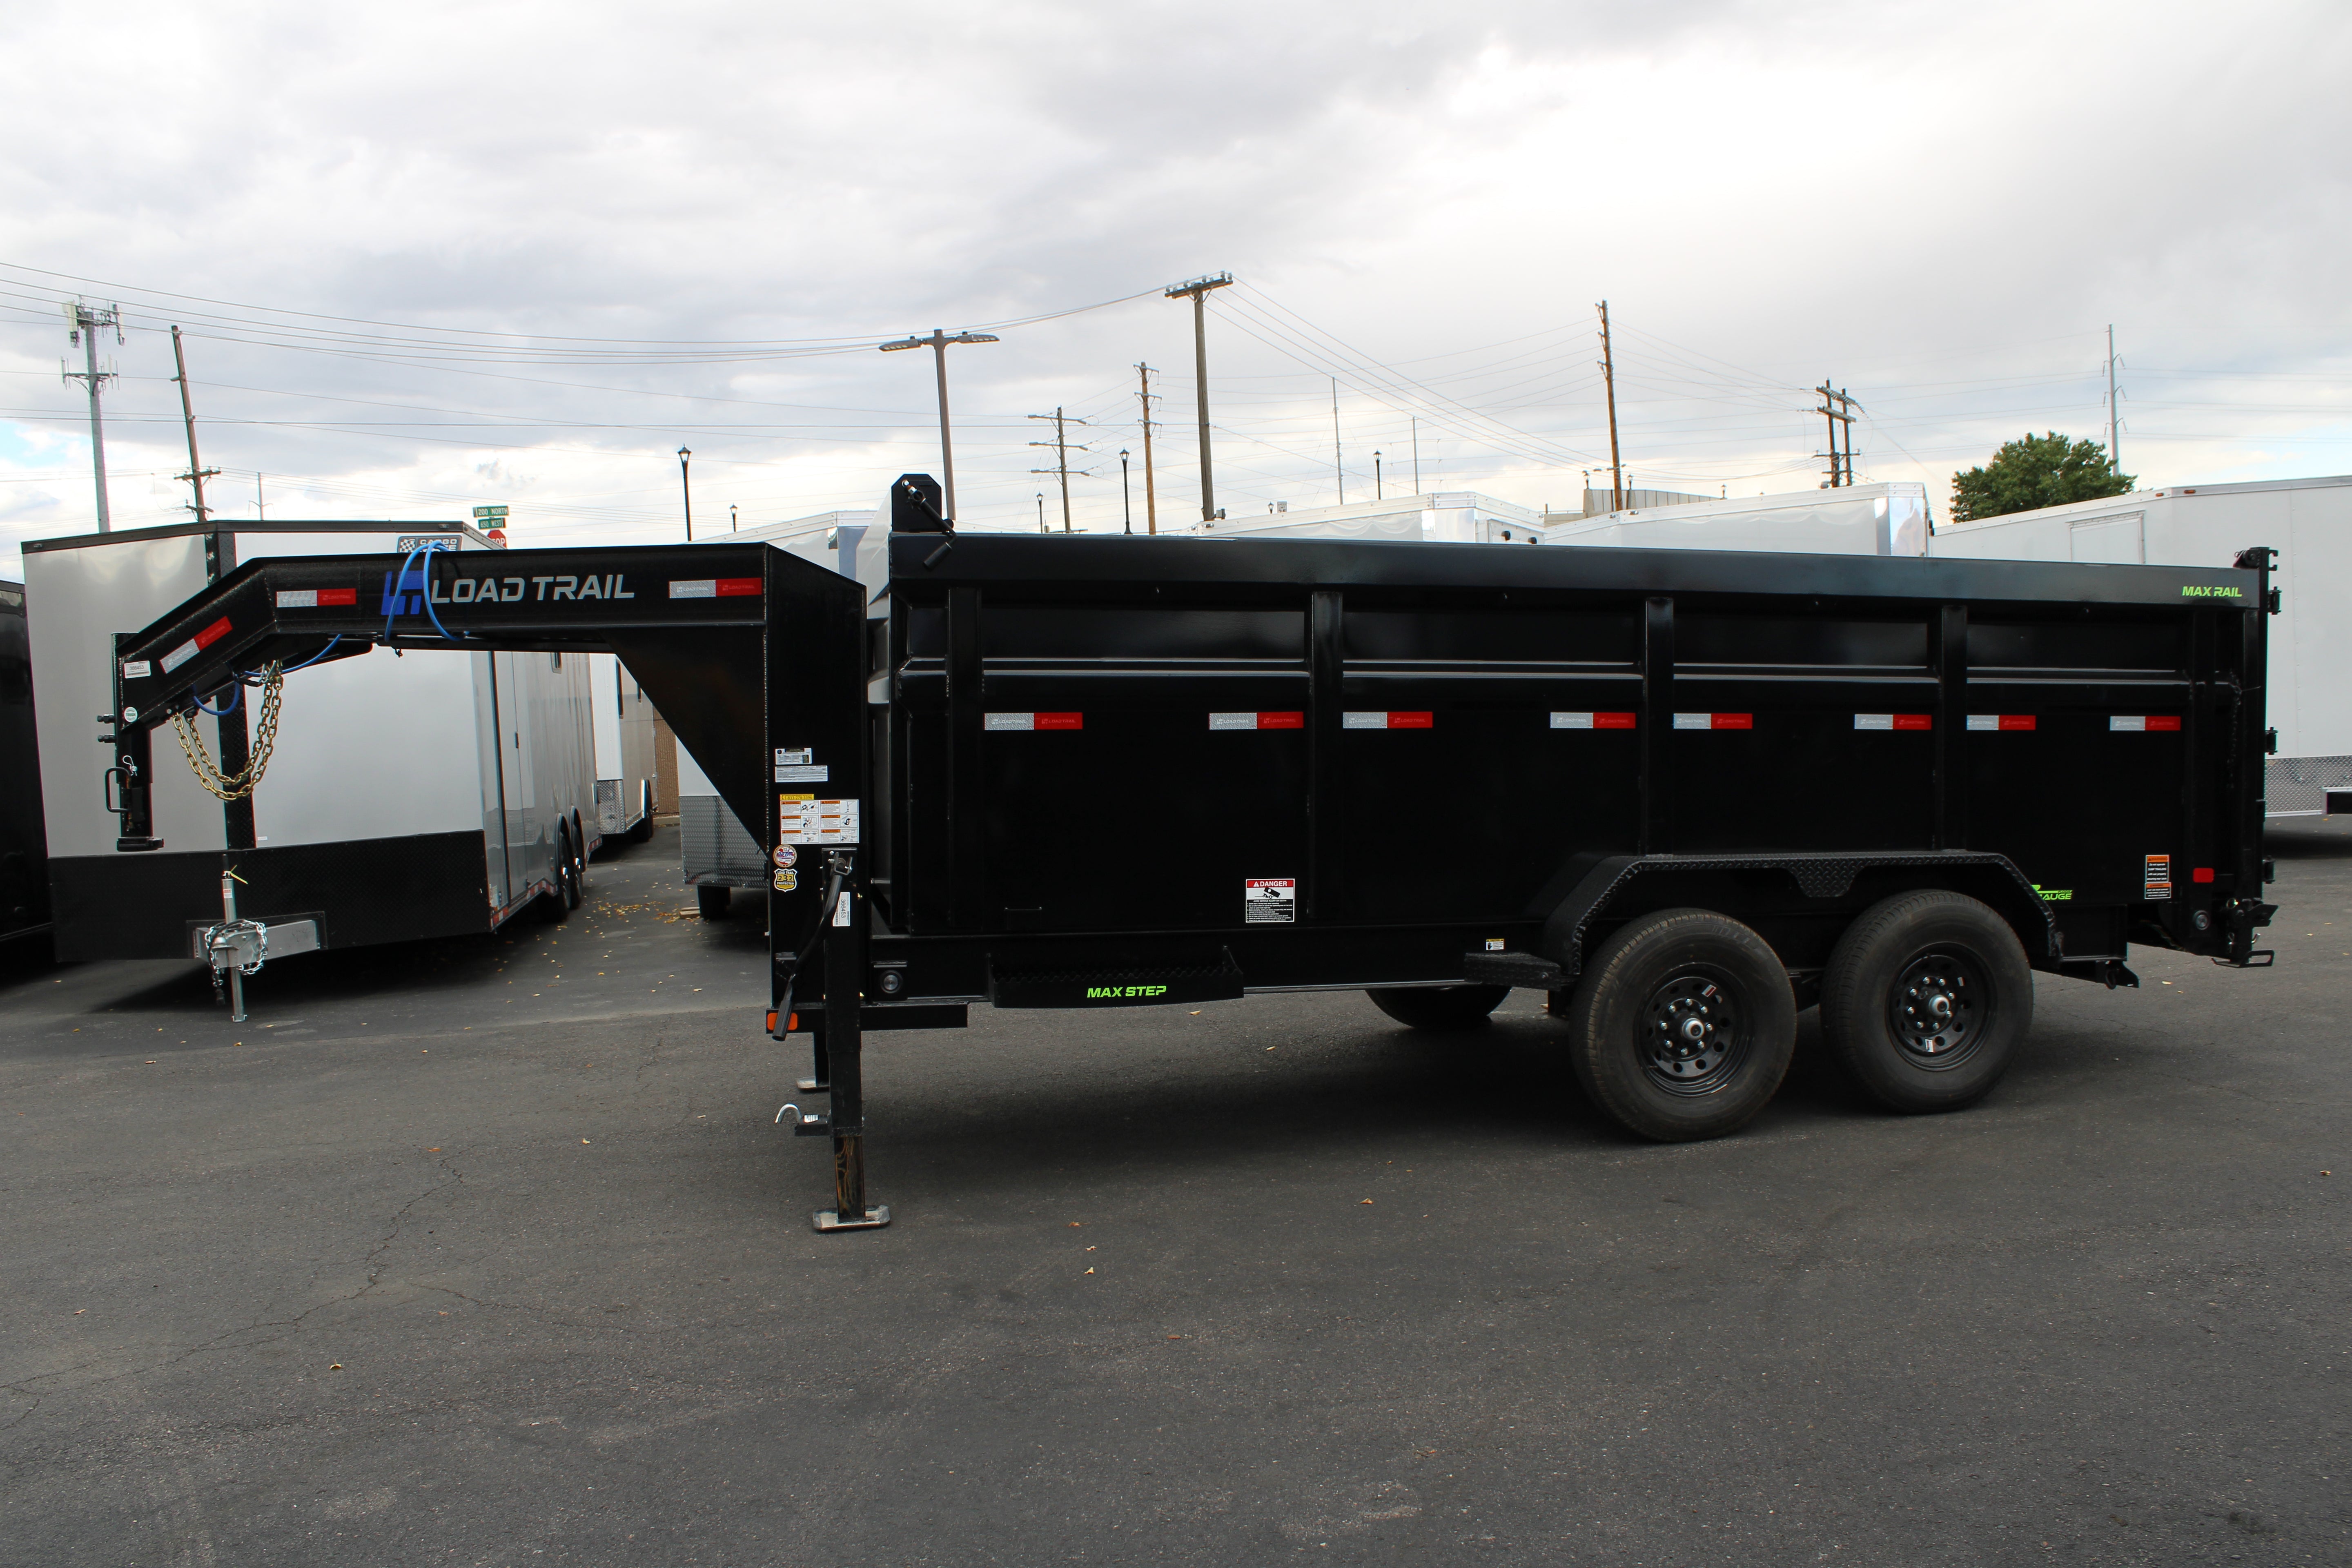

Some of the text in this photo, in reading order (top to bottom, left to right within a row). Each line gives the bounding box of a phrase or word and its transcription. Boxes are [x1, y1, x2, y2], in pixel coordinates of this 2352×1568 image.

[431, 577, 525, 604] LOAD
[532, 574, 635, 601] TRAIL
[2182, 586, 2243, 597] MAX RAIL
[1087, 985, 1167, 998] MAX STEP
